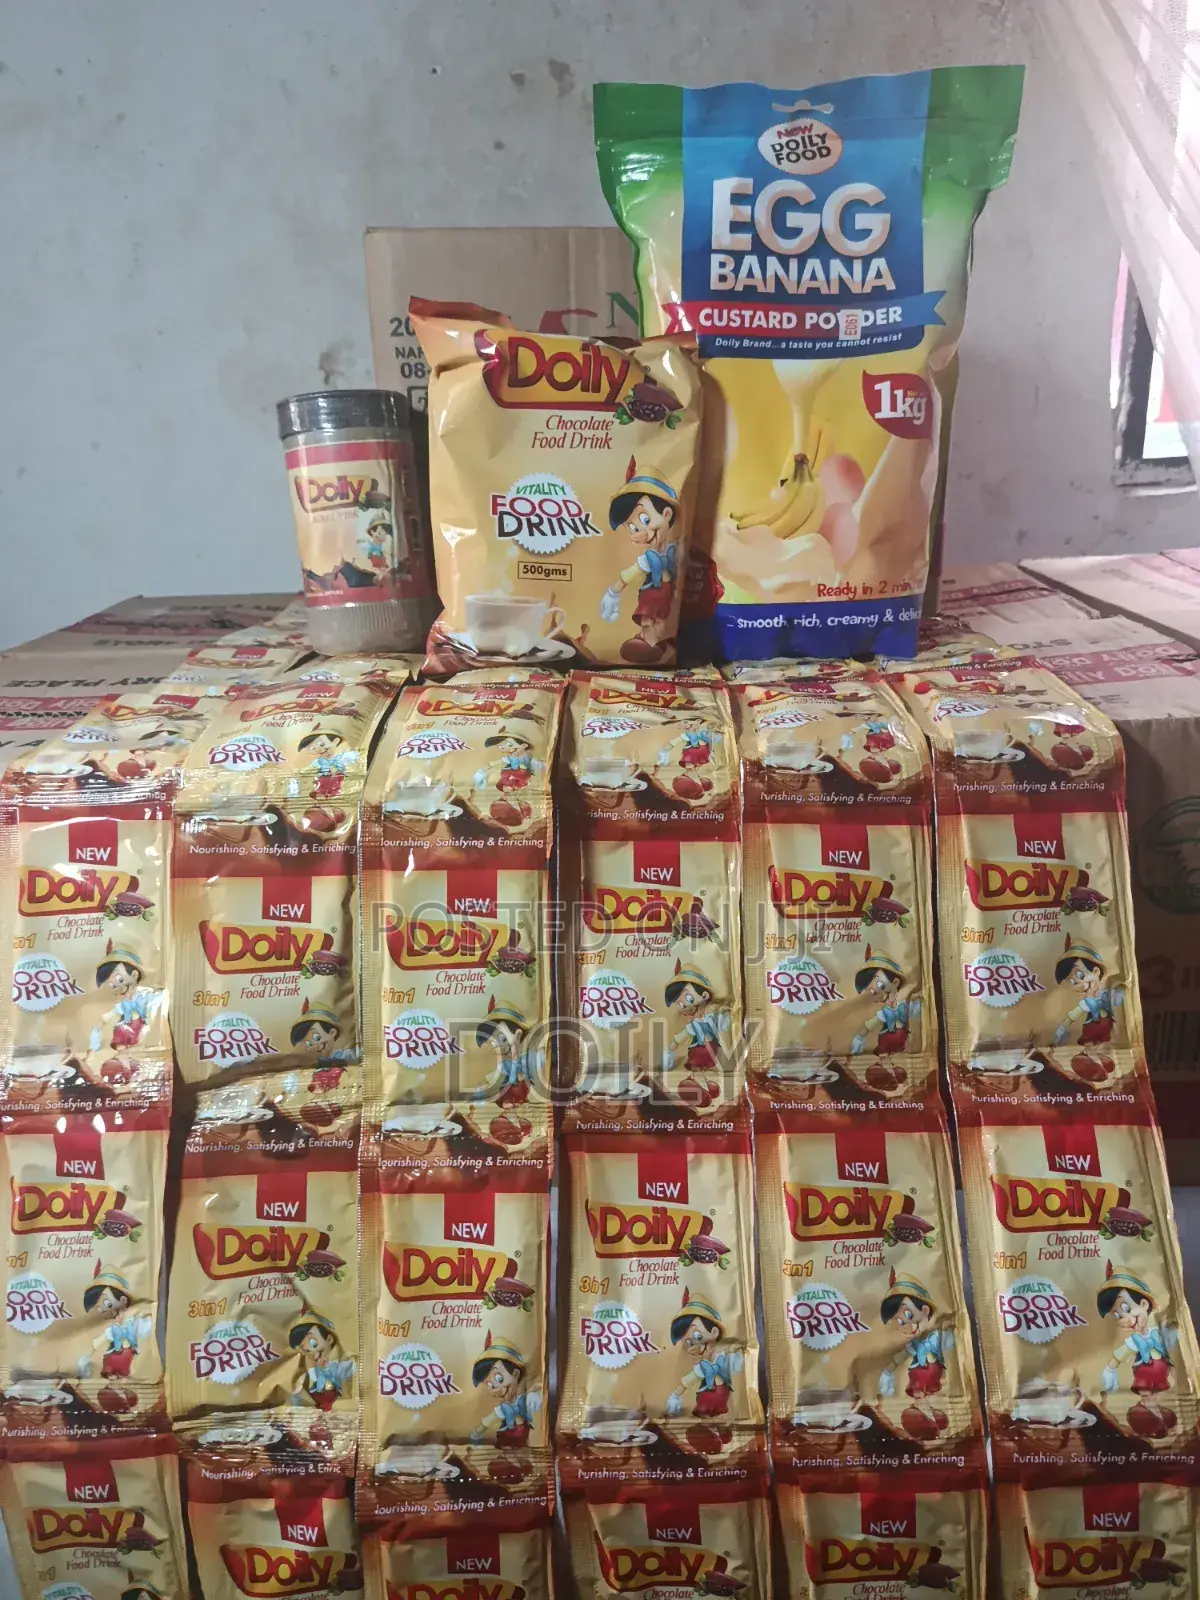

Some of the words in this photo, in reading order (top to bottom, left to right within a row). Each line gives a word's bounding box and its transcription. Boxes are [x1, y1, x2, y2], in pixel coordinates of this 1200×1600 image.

[770, 132, 827, 153] DOILY
[774, 145, 832, 165] FOOD
[711, 177, 892, 257] EGG
[709, 254, 896, 294] BANANA
[699, 307, 798, 329] CUSTARD
[805, 306, 903, 329] PODER
[788, 341, 813, 349] taste
[815, 342, 831, 351] you
[835, 337, 871, 348] cannot
[872, 332, 902, 345] resist
[508, 337, 631, 405] Doily
[545, 415, 614, 432] Chocolate
[531, 432, 565, 449] Food
[569, 432, 613, 450] Drink
[516, 482, 567, 496] VITALITY
[491, 494, 583, 518] FOOD
[497, 511, 602, 538] DRINK
[522, 564, 568, 579] 500gms
[817, 581, 857, 600] Ready
[862, 582, 873, 596] in
[878, 580, 888, 594] 2
[827, 613, 879, 628] creamy
[883, 608, 894, 622] &
[209, 743, 277, 755] FOOD
[209, 750, 287, 764] DRINK
[1000, 781, 1047, 792] Satisfying
[1060, 780, 1105, 792] Enriching
[624, 810, 668, 821] Satisfying
[680, 810, 724, 821] Enriching
[189, 844, 249, 856] Nourishing,
[251, 844, 298, 856] Satisfying
[301, 844, 308, 853] &
[312, 843, 356, 855] Enriching
[435, 837, 484, 849] Satisfying
[498, 837, 544, 849] Enriching
[1024, 840, 1057, 855] NEW
[75, 847, 111, 862] NEW
[828, 850, 862, 865] NEW
[640, 867, 673, 881] NEW
[981, 862, 1069, 904] Doily
[784, 872, 872, 913] Doily
[269, 904, 305, 919] NEW
[455, 898, 490, 913] NEW
[597, 889, 683, 930] Doily
[57, 915, 105, 928] Chocolate
[1012, 910, 1061, 922] Chocolate
[47, 929, 71, 940] Food
[74, 927, 104, 939] Drink
[1003, 923, 1028, 936] Food
[1031, 921, 1061, 934] Drink
[221, 926, 314, 969] Doily
[406, 921, 499, 966] Doily
[977, 954, 1017, 965] VITALITY
[250, 973, 300, 986] Chocolate
[435, 970, 486, 983] Chocolate
[964, 964, 1030, 981] FOOD
[240, 988, 265, 999] Food
[268, 987, 300, 998] Drink
[426, 984, 450, 996] Food
[453, 984, 486, 995] Drink
[771, 983, 844, 1003] DRINK
[968, 974, 1045, 997] DRINK
[192, 990, 230, 1007] 3in1
[580, 987, 639, 1001] FOOD
[582, 997, 654, 1018] DRINK
[212, 1017, 251, 1027] VITALITY
[194, 1028, 264, 1045] FOOD
[199, 1038, 279, 1060] DRINK
[386, 1037, 464, 1058] DRINK
[818, 1101, 866, 1111] Satisfying
[879, 1101, 924, 1111] Enriching
[1023, 1093, 1073, 1105] Satisfying
[1087, 1092, 1135, 1104] Enriching
[626, 1120, 674, 1131] Satisfying
[688, 1120, 734, 1131] Enriching
[185, 1142, 243, 1154] Nourishing,
[246, 1140, 295, 1152] Satisfying
[308, 1138, 353, 1149] Enriching
[64, 1160, 97, 1175] NEW
[433, 1156, 483, 1169] Satisfying
[496, 1157, 543, 1168] Enriching
[845, 1162, 880, 1178] NEW
[1055, 1155, 1091, 1171] NEW
[646, 1182, 681, 1198] NEW
[18, 1183, 106, 1227] Doily
[263, 1201, 299, 1217] NEW
[801, 1187, 892, 1232] Doily
[1009, 1180, 1105, 1225] Doily
[451, 1223, 488, 1239] NEW
[600, 1207, 691, 1252] Doily
[833, 1241, 884, 1254] Chocolate
[1047, 1233, 1099, 1246] Chocolate
[216, 1226, 308, 1271] Doily
[629, 1259, 680, 1273] Chocolate
[824, 1255, 850, 1269] Food
[853, 1254, 886, 1267] Drink
[402, 1248, 496, 1295] Doily
[619, 1273, 644, 1287] Food
[647, 1273, 680, 1285] Drink
[1012, 1282, 1054, 1295] VITALITY
[188, 1298, 228, 1317] 3in1
[432, 1301, 483, 1314] Chocolate
[421, 1315, 447, 1329] Food
[450, 1315, 483, 1327] Drink
[791, 1313, 870, 1339] DRINK
[1003, 1307, 1088, 1333] DRINK
[190, 1334, 265, 1360] FOOD
[195, 1348, 281, 1379] DRINK
[380, 1376, 460, 1396] DRINK
[846, 1454, 899, 1467] Satisfying
[914, 1454, 965, 1467] Enriching
[201, 1468, 257, 1480] Nourishing,
[74, 1484, 109, 1500] NEW
[433, 1498, 484, 1513] Satisfying
[33, 1508, 125, 1547] Doily
[869, 1520, 908, 1535] NEW
[1093, 1512, 1131, 1528] NEW
[287, 1525, 319, 1543] NEW
[656, 1528, 693, 1540] NEW
[456, 1557, 492, 1571] NEW
[611, 1546, 704, 1583] Doily
[820, 1538, 918, 1580] Doily
[1044, 1536, 1142, 1580] Doily
[246, 1548, 333, 1589] Doily
